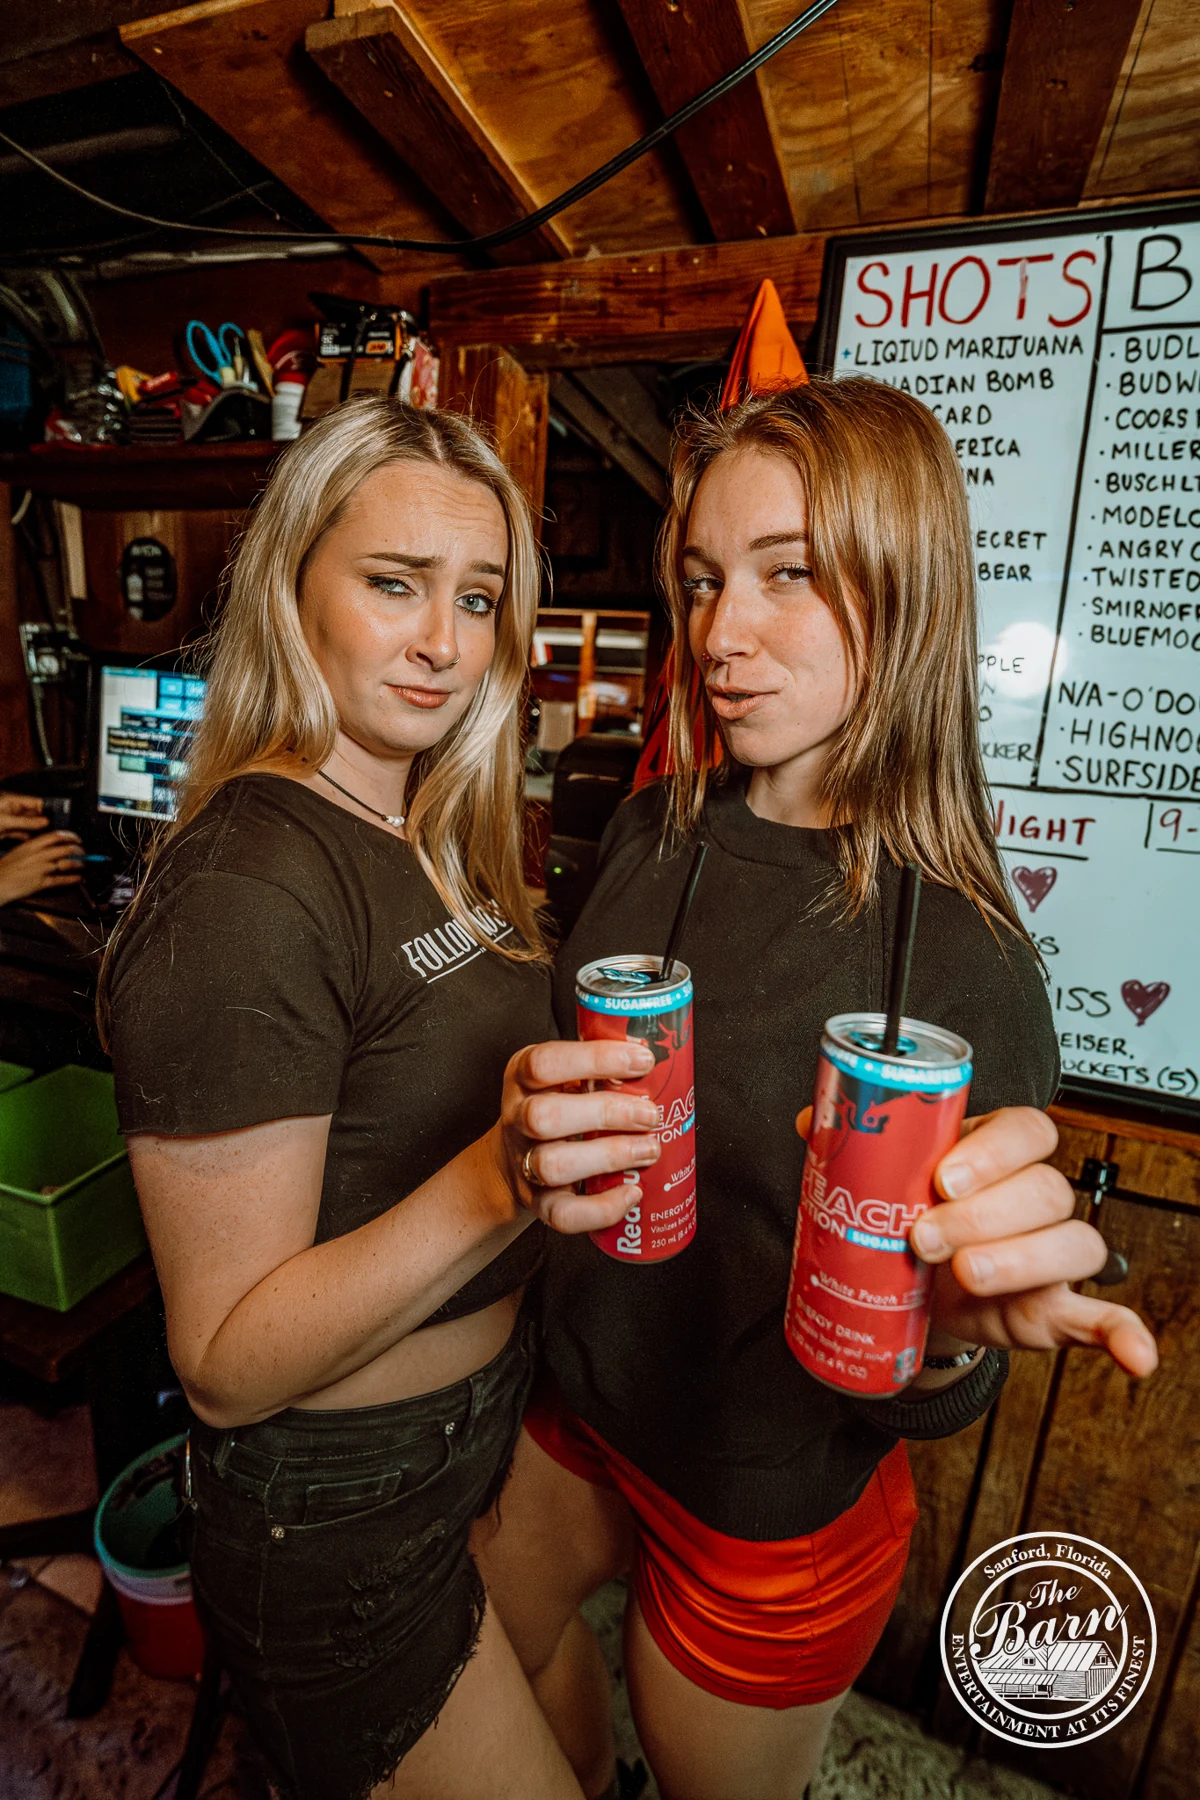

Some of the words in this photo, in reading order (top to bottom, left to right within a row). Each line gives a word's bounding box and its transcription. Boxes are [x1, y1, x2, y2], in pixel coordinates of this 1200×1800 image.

[855, 250, 1096, 328] SHOTS
[855, 338, 939, 366] LIQIUD
[946, 334, 1084, 359] MARIJUANA
[986, 368, 1055, 393] BOMB
[1119, 370, 1200, 396] BUDW
[1116, 407, 1188, 430] COORS
[1111, 440, 1200, 461] MILLER
[1099, 539, 1183, 559] ANGRY
[978, 563, 1032, 582] BEAR
[1091, 567, 1200, 592] TWISTED
[1092, 597, 1200, 621] SMIRNOF
[1070, 718, 1200, 753] HIGHNO
[1062, 755, 1200, 793] SURFSIDE
[605, 994, 672, 1011] SUGARFREE
[650, 1201, 684, 1222] ENERGY
[651, 1238, 666, 1249] 250
